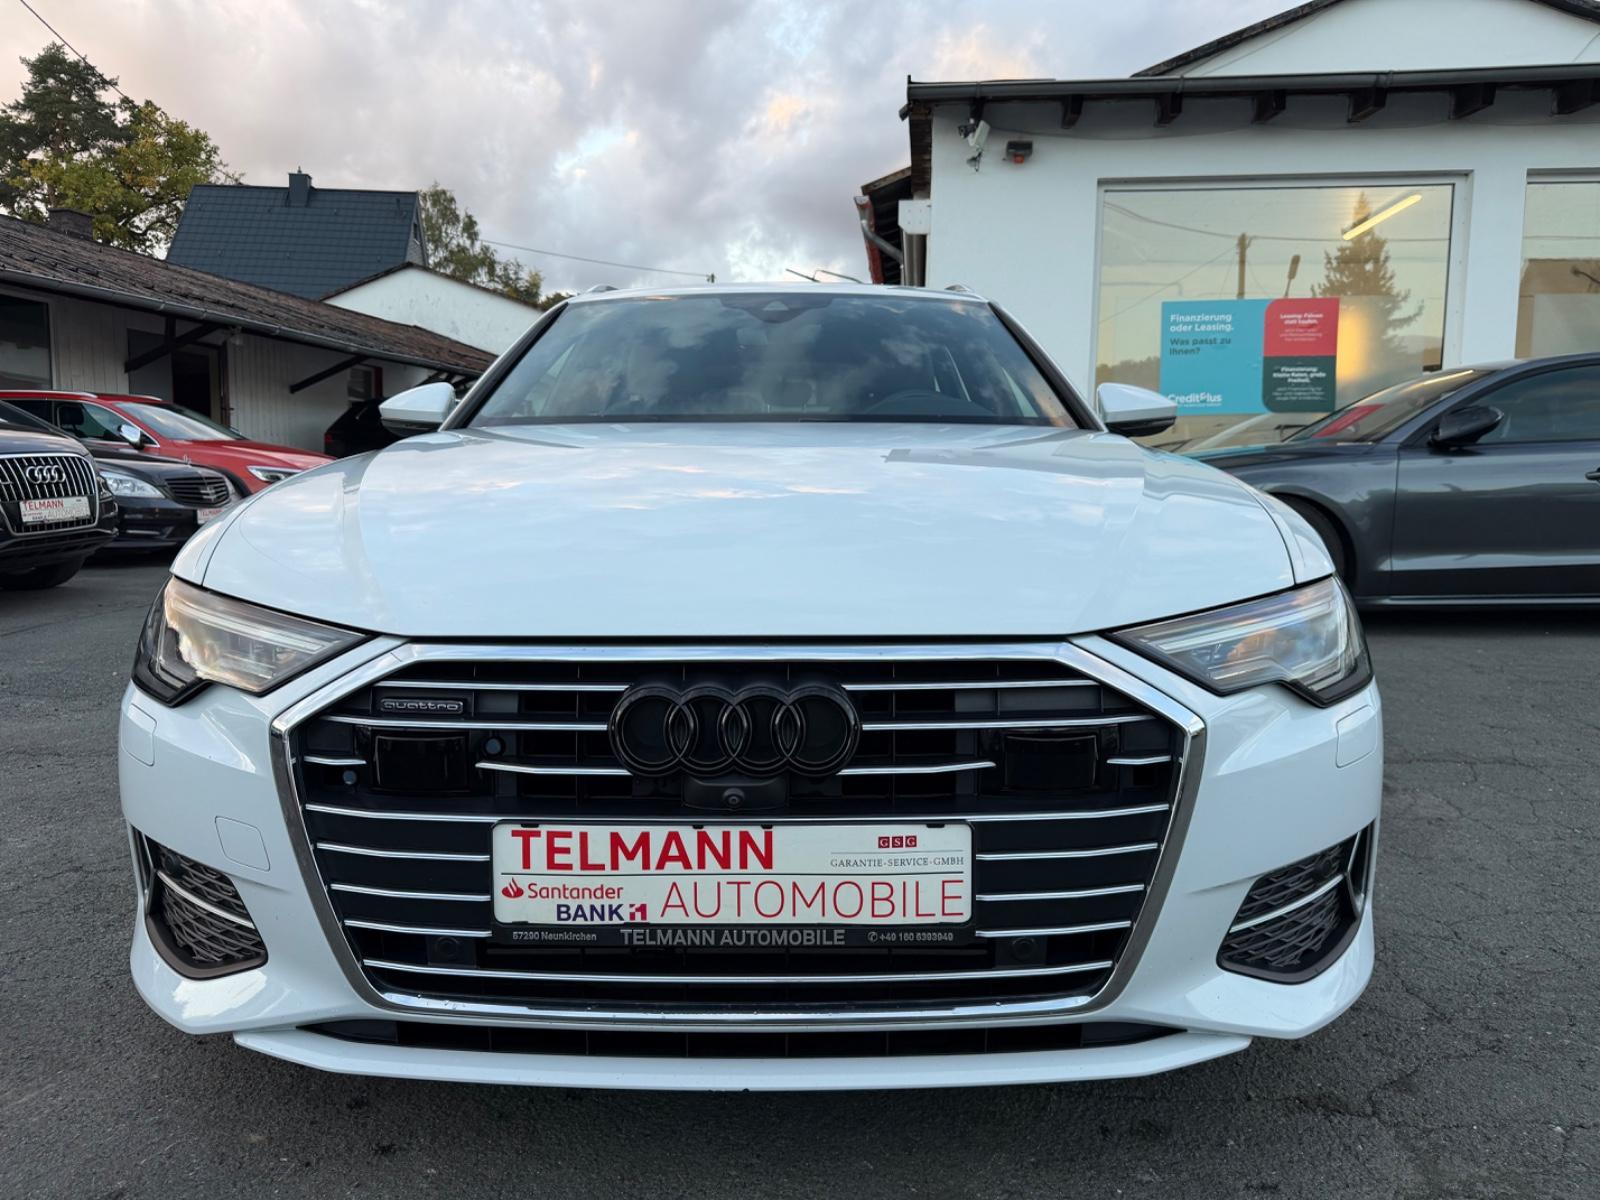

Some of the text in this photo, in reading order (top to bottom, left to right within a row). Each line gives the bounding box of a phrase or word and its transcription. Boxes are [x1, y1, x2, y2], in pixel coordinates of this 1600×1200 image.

[1170, 313, 1232, 323] Finanzierung
[1169, 322, 1234, 333] oder Leasing.
[1169, 336, 1232, 346] Was passt zu
[1169, 346, 1201, 356] Ihnen?
[1168, 392, 1223, 404] CreditPlus
[22, 499, 64, 511] TELMANN
[383, 701, 459, 710] quattro
[878, 835, 917, 848] GSG
[511, 829, 773, 871] TELMANN
[528, 883, 624, 900] Santander
[660, 880, 964, 919] AUTOMOBILE
[541, 931, 597, 941] Neunkirchen
[620, 929, 715, 945] TELMANN
[720, 929, 845, 945] AUTOMOBILE
